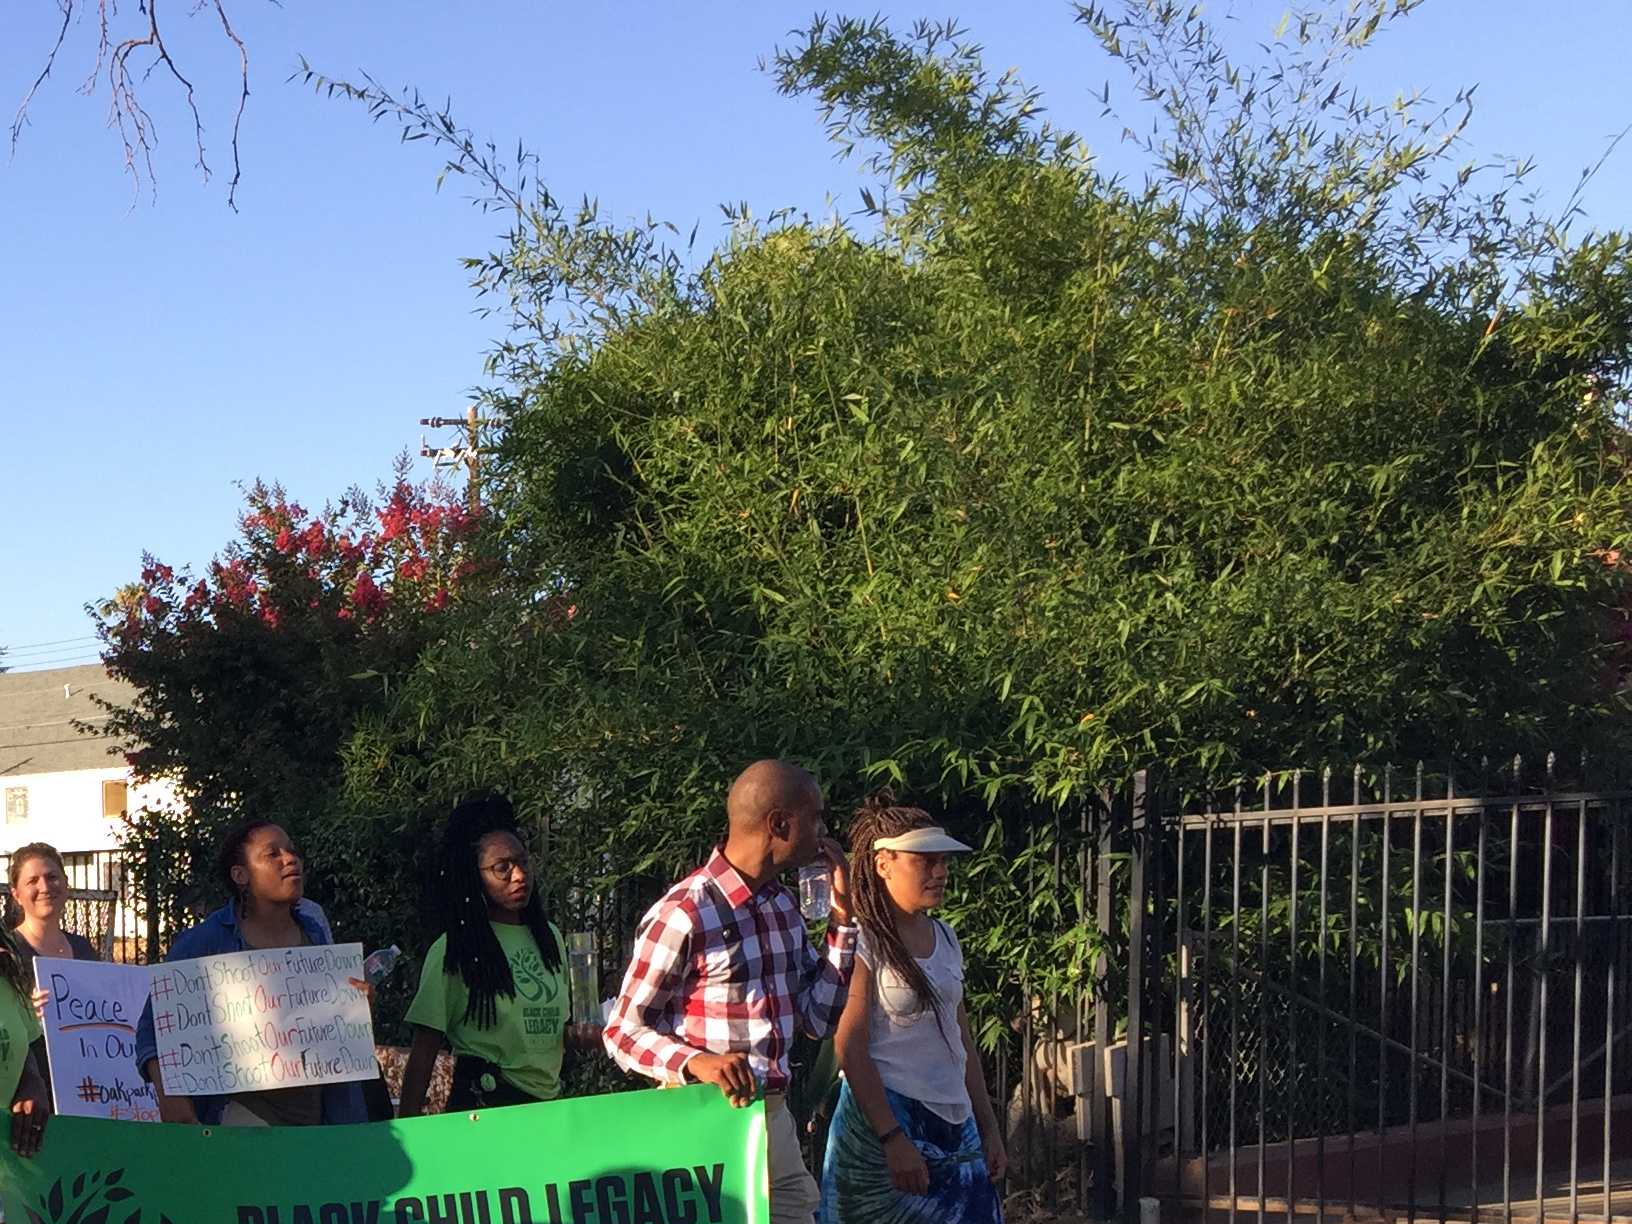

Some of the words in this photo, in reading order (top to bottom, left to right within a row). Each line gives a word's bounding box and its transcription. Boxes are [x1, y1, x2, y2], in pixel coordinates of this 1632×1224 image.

[51, 974, 128, 1022] Peace
[524, 1018, 559, 1034] LEGACY
[80, 1037, 98, 1058] In
[106, 1034, 136, 1059] Ou
